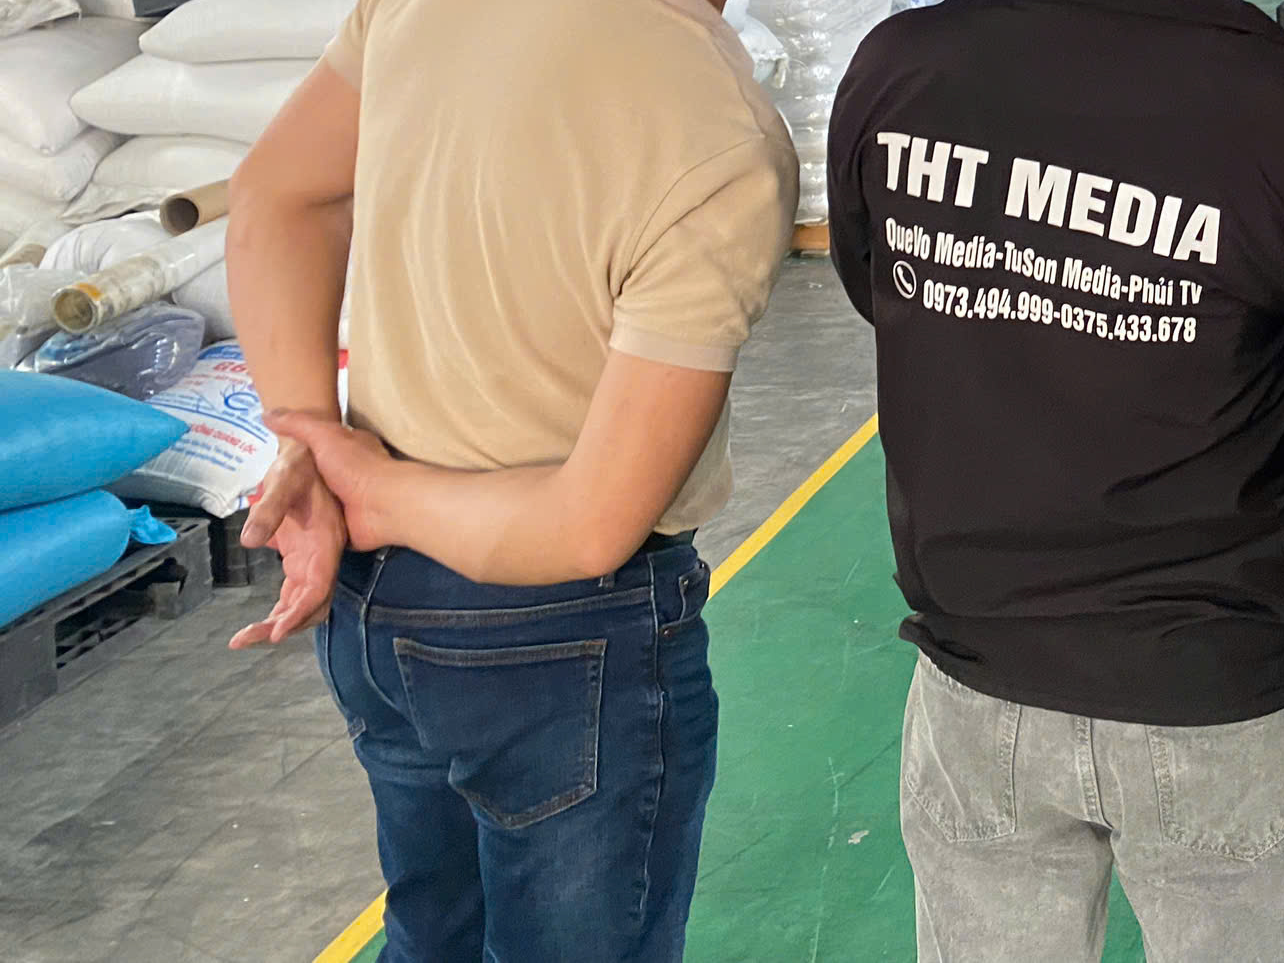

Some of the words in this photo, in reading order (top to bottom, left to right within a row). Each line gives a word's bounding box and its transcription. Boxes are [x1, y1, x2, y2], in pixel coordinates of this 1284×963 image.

[877, 131, 990, 209] THT
[1004, 157, 1222, 265] MEDIA
[885, 217, 931, 261] QueVo
[933, 232, 1058, 285] Media-TuSon
[1061, 257, 1174, 307] Media-Phủi
[1179, 280, 1203, 306] TV
[923, 279, 1198, 344] 0973.494.999-0375.433.678
